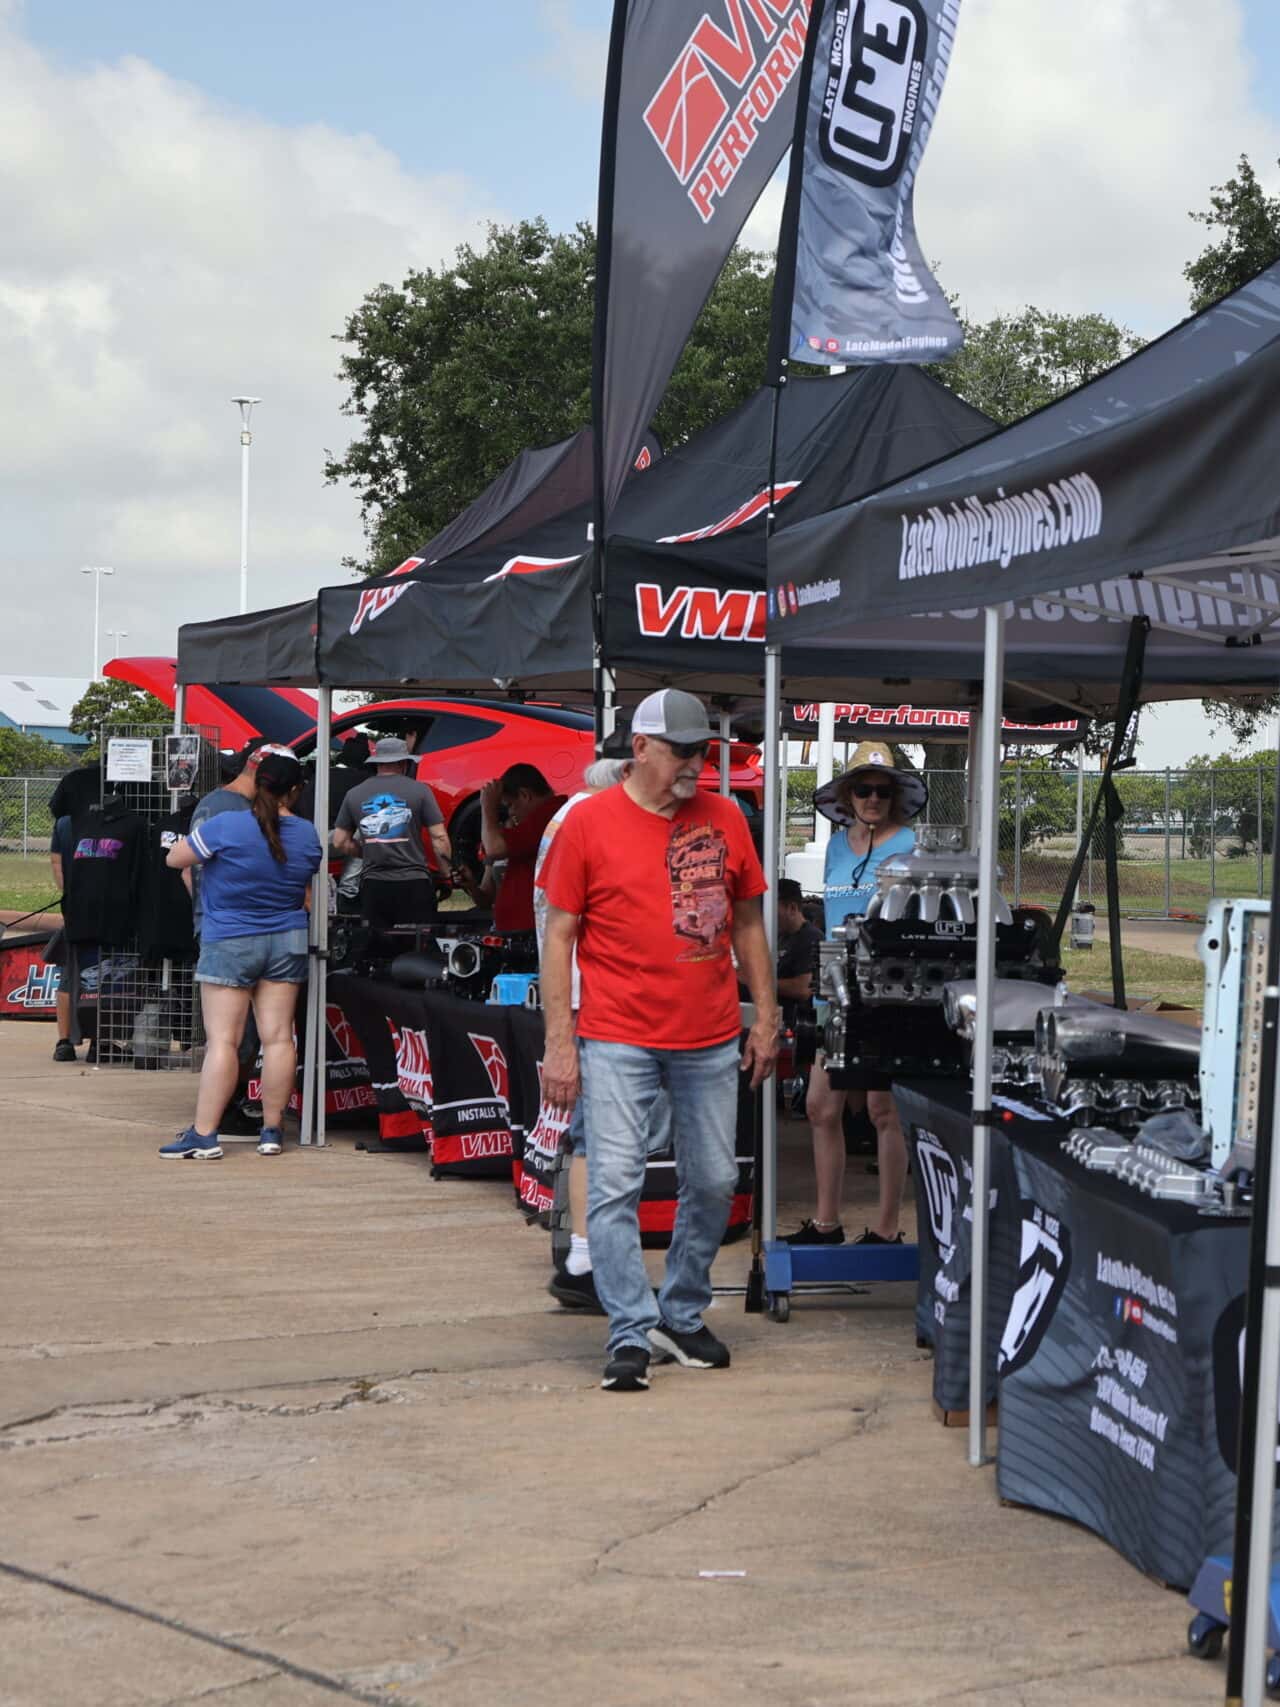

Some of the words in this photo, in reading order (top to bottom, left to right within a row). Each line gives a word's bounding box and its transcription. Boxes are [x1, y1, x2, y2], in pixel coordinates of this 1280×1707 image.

[822, 77, 839, 120] LATE
[831, 8, 849, 67] MODEL
[902, 60, 923, 134] ENGINES
[457, 1106, 497, 1123] INSTALLS
